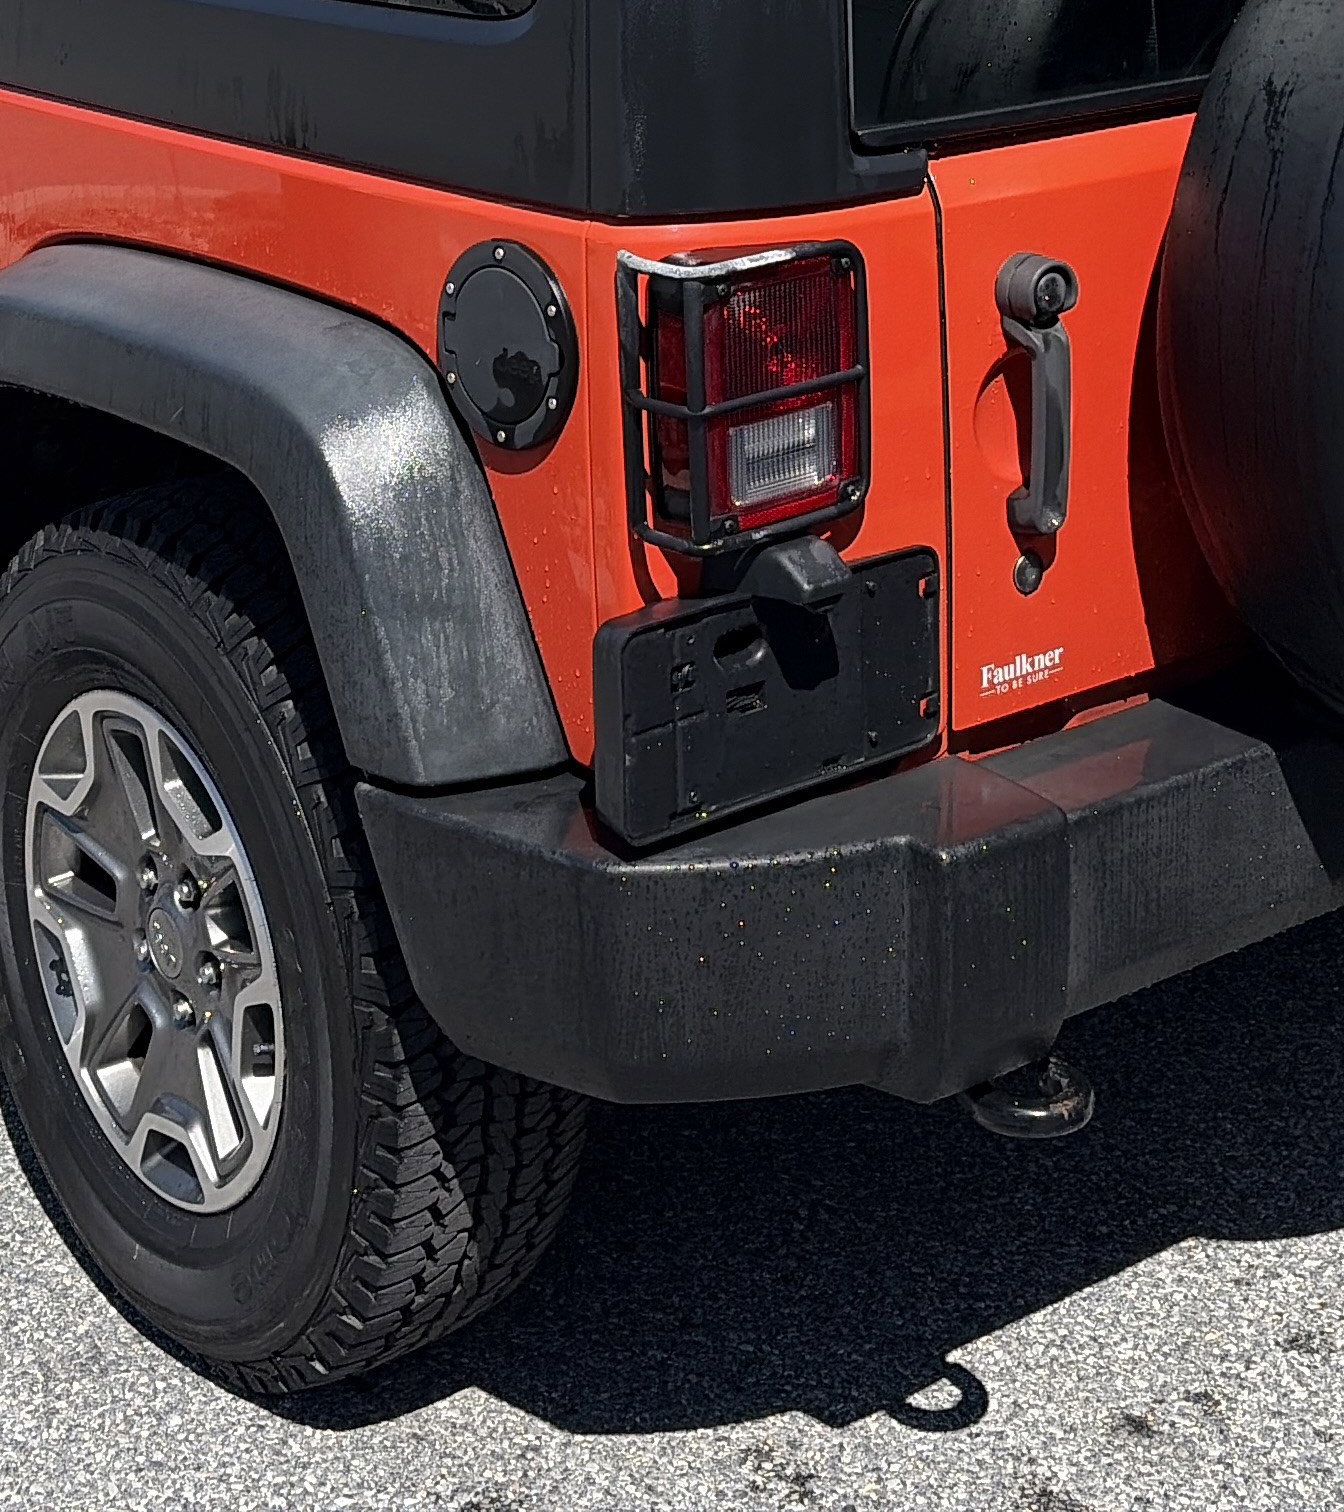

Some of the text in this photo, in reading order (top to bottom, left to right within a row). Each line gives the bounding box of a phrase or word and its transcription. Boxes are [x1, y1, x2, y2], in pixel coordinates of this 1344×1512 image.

[980, 647, 1064, 689] Faulkner
[995, 669, 1050, 695] TO BE SURE
